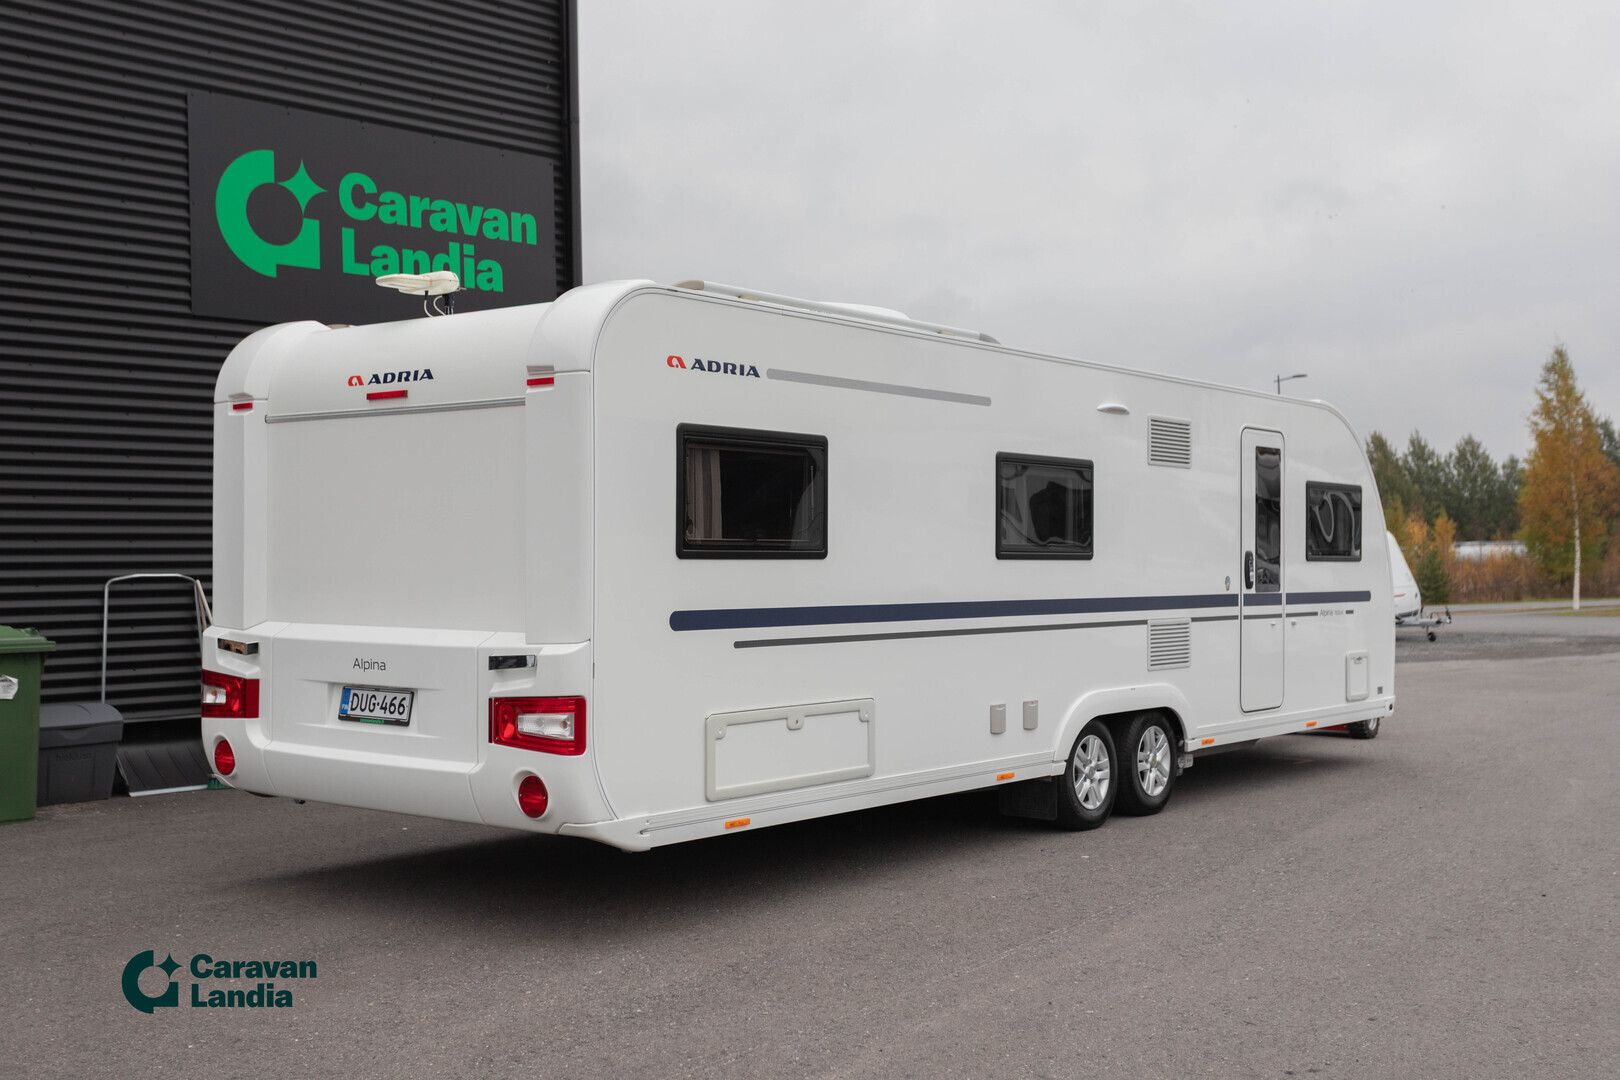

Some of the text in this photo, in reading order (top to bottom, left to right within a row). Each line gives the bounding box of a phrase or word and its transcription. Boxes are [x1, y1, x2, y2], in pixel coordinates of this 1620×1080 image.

[338, 171, 538, 246] Caravan
[341, 226, 505, 293] Landia
[368, 368, 434, 385] ADRIA
[691, 358, 761, 379] ADRIA
[352, 657, 387, 672] Alpina
[350, 692, 407, 716] DUG-466
